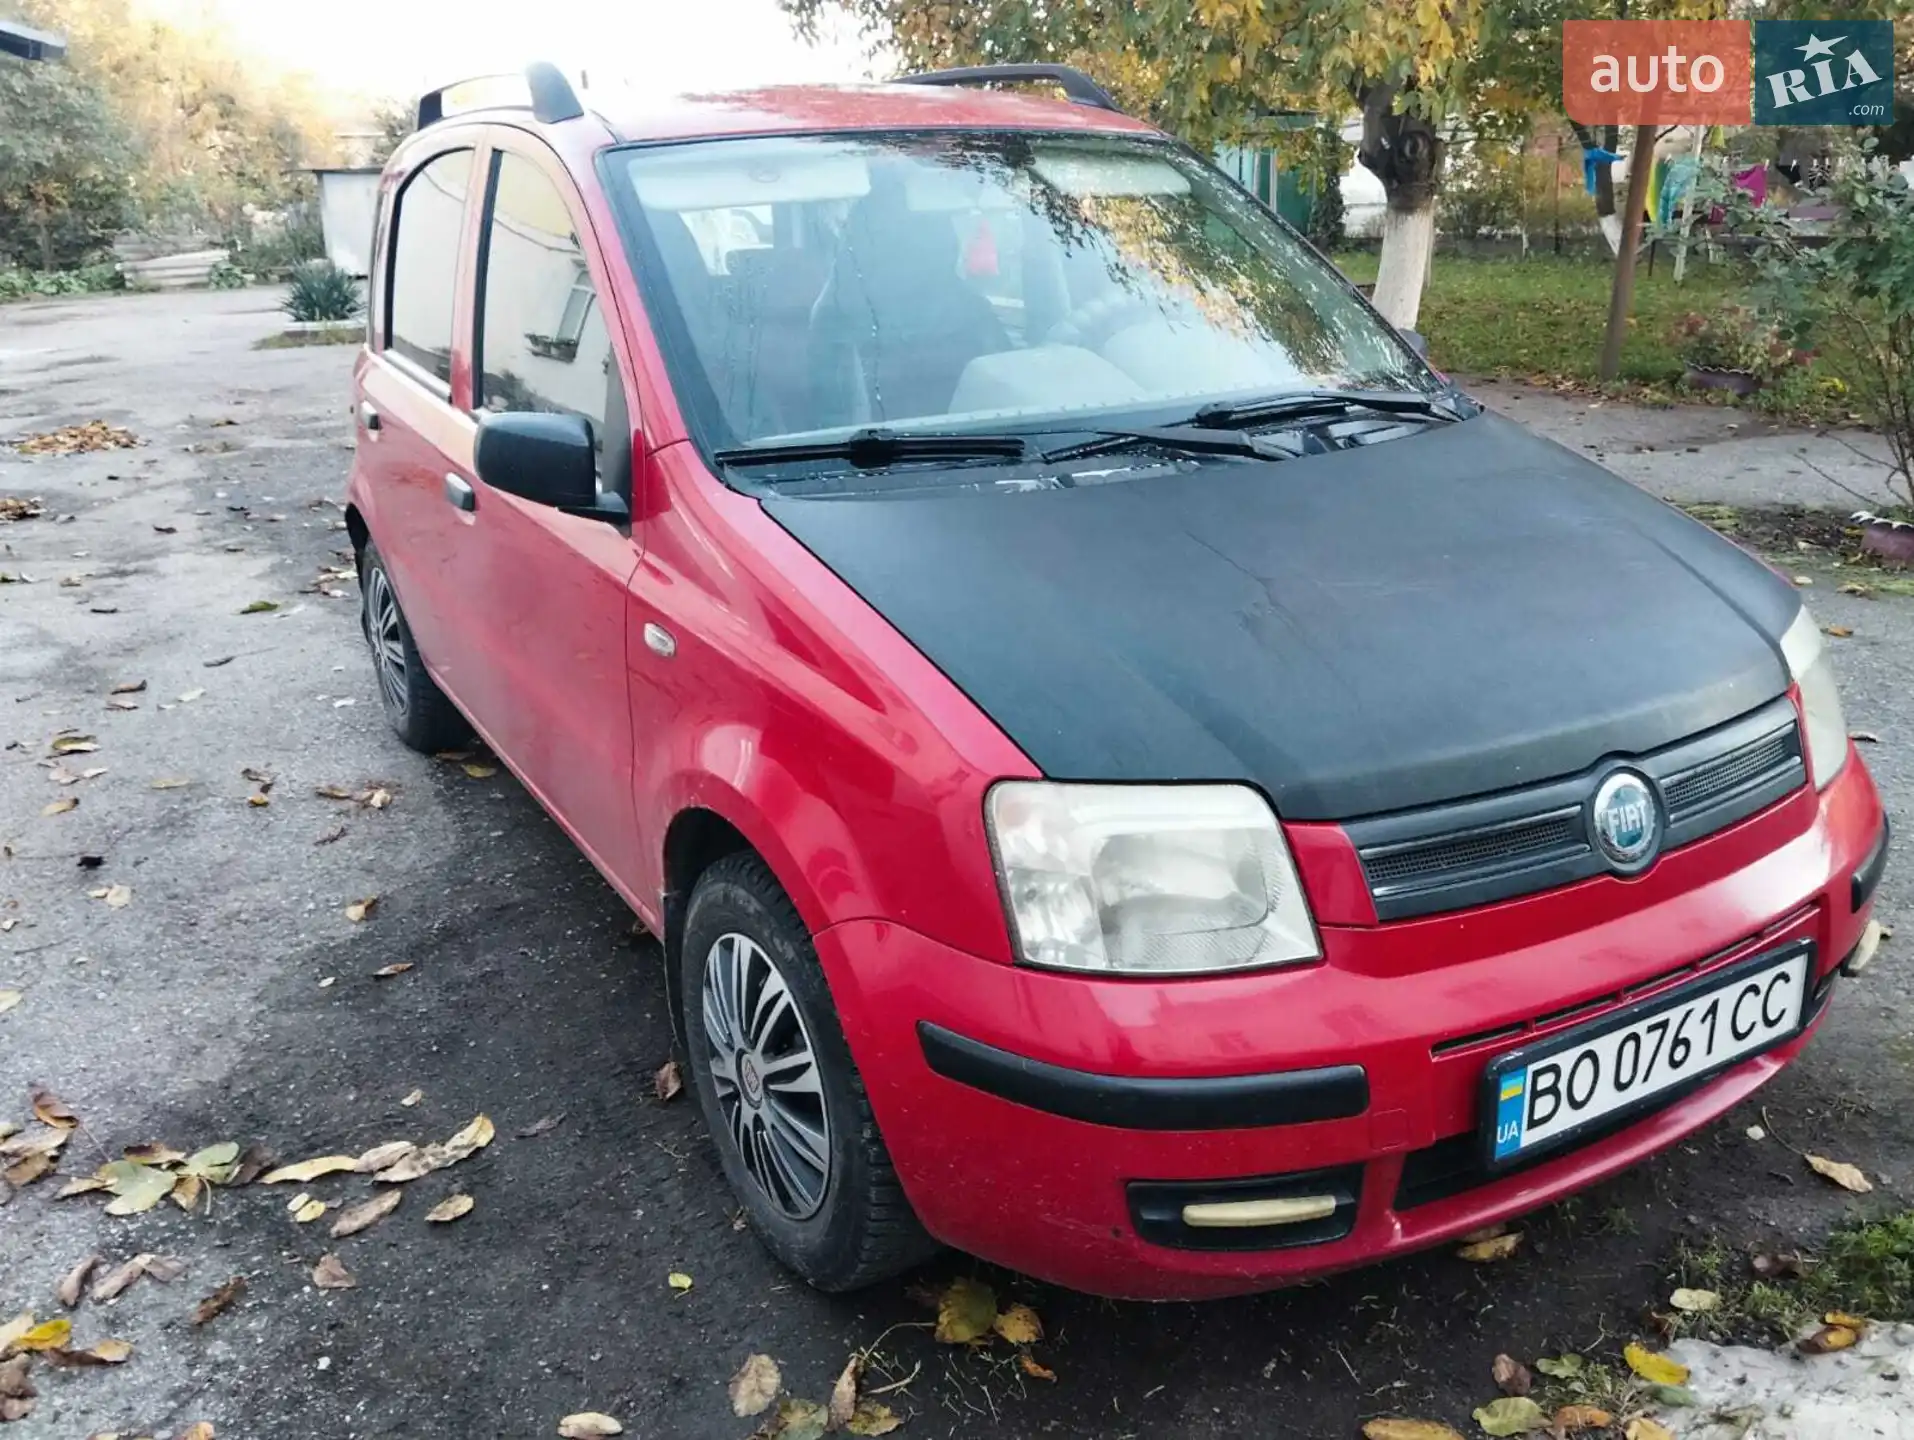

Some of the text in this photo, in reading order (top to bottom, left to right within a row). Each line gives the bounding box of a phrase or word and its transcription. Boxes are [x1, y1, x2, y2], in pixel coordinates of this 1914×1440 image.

[1606, 802, 1646, 839] FIAT
[1527, 971, 1791, 1130] BO 0761 CC
[1497, 1120, 1519, 1143] UA
